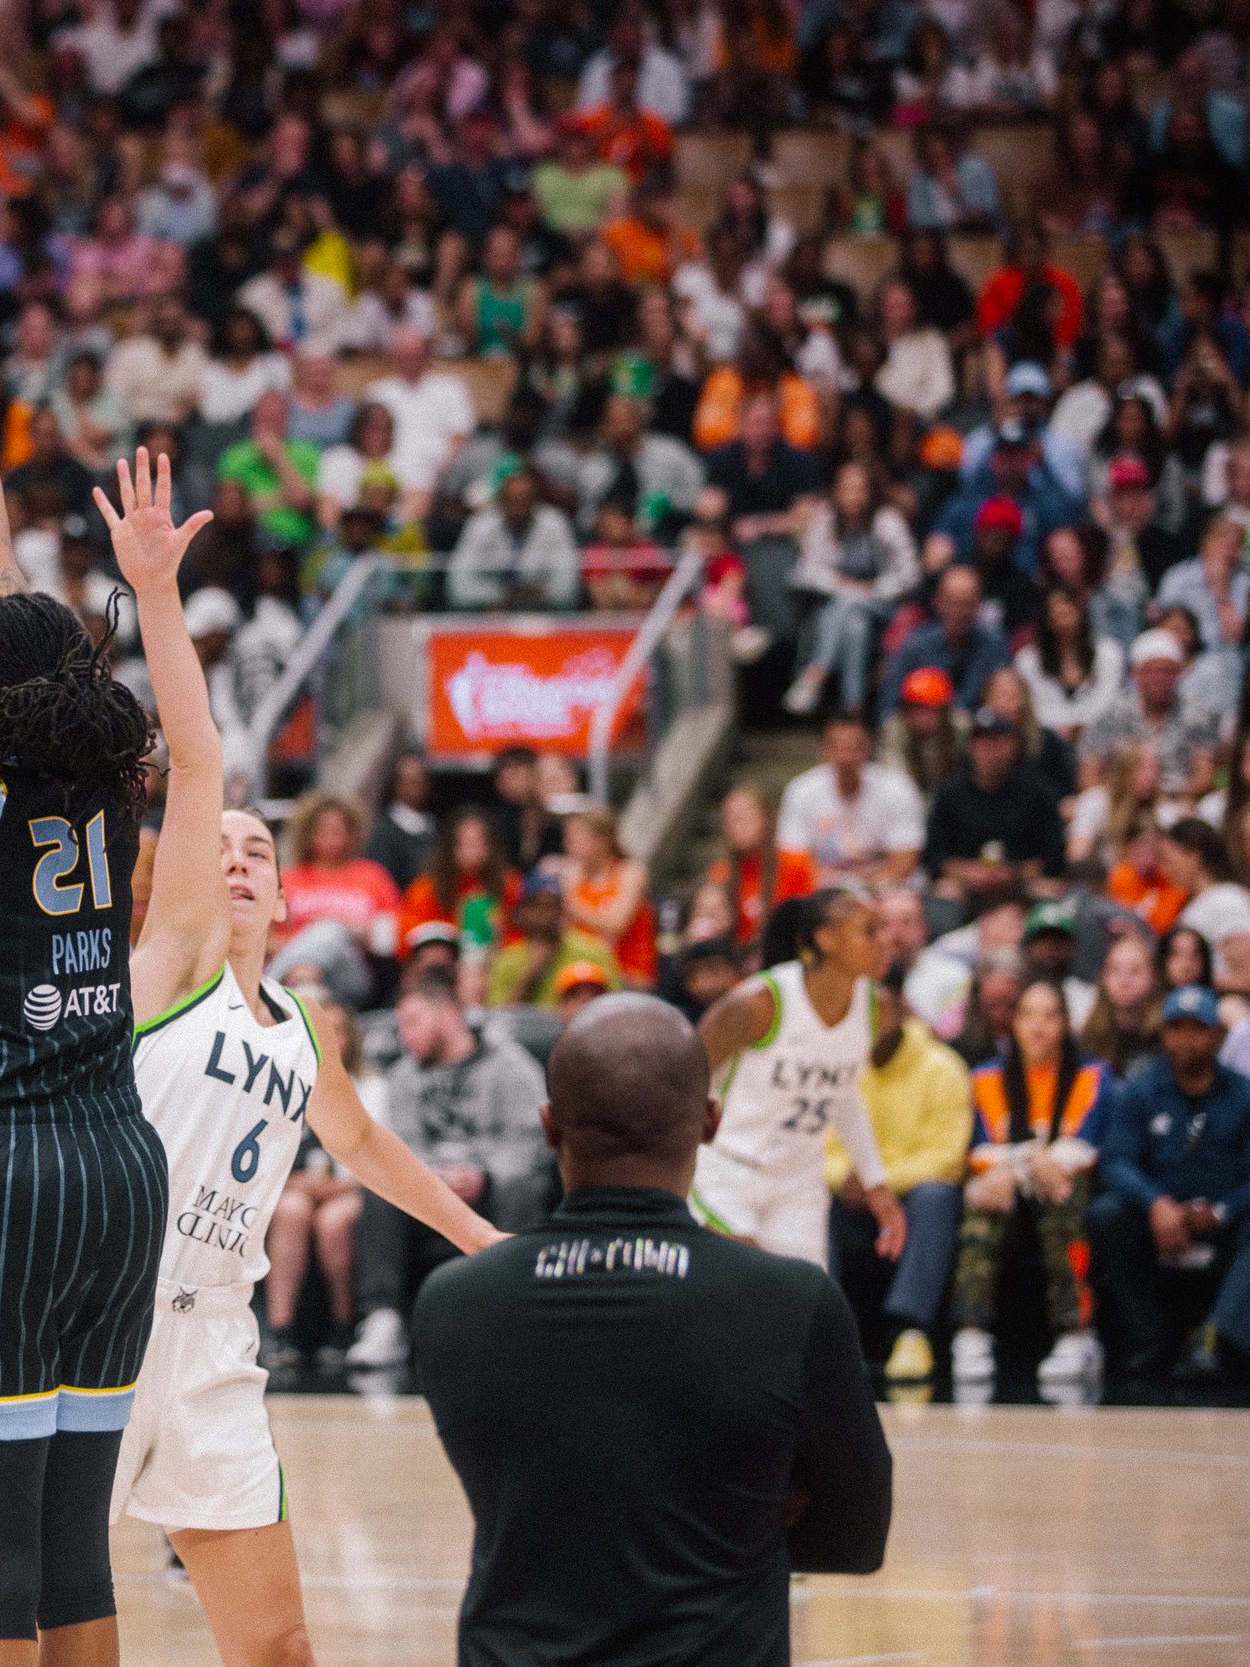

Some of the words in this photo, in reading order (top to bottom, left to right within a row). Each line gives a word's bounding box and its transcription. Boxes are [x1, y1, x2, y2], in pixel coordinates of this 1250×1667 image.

[28, 809, 113, 916] 21
[52, 927, 112, 975] PARKS
[63, 982, 121, 1018] AT&T
[204, 1031, 312, 1123] LYNX
[782, 1097, 833, 1136] 25
[231, 1118, 269, 1183] 6
